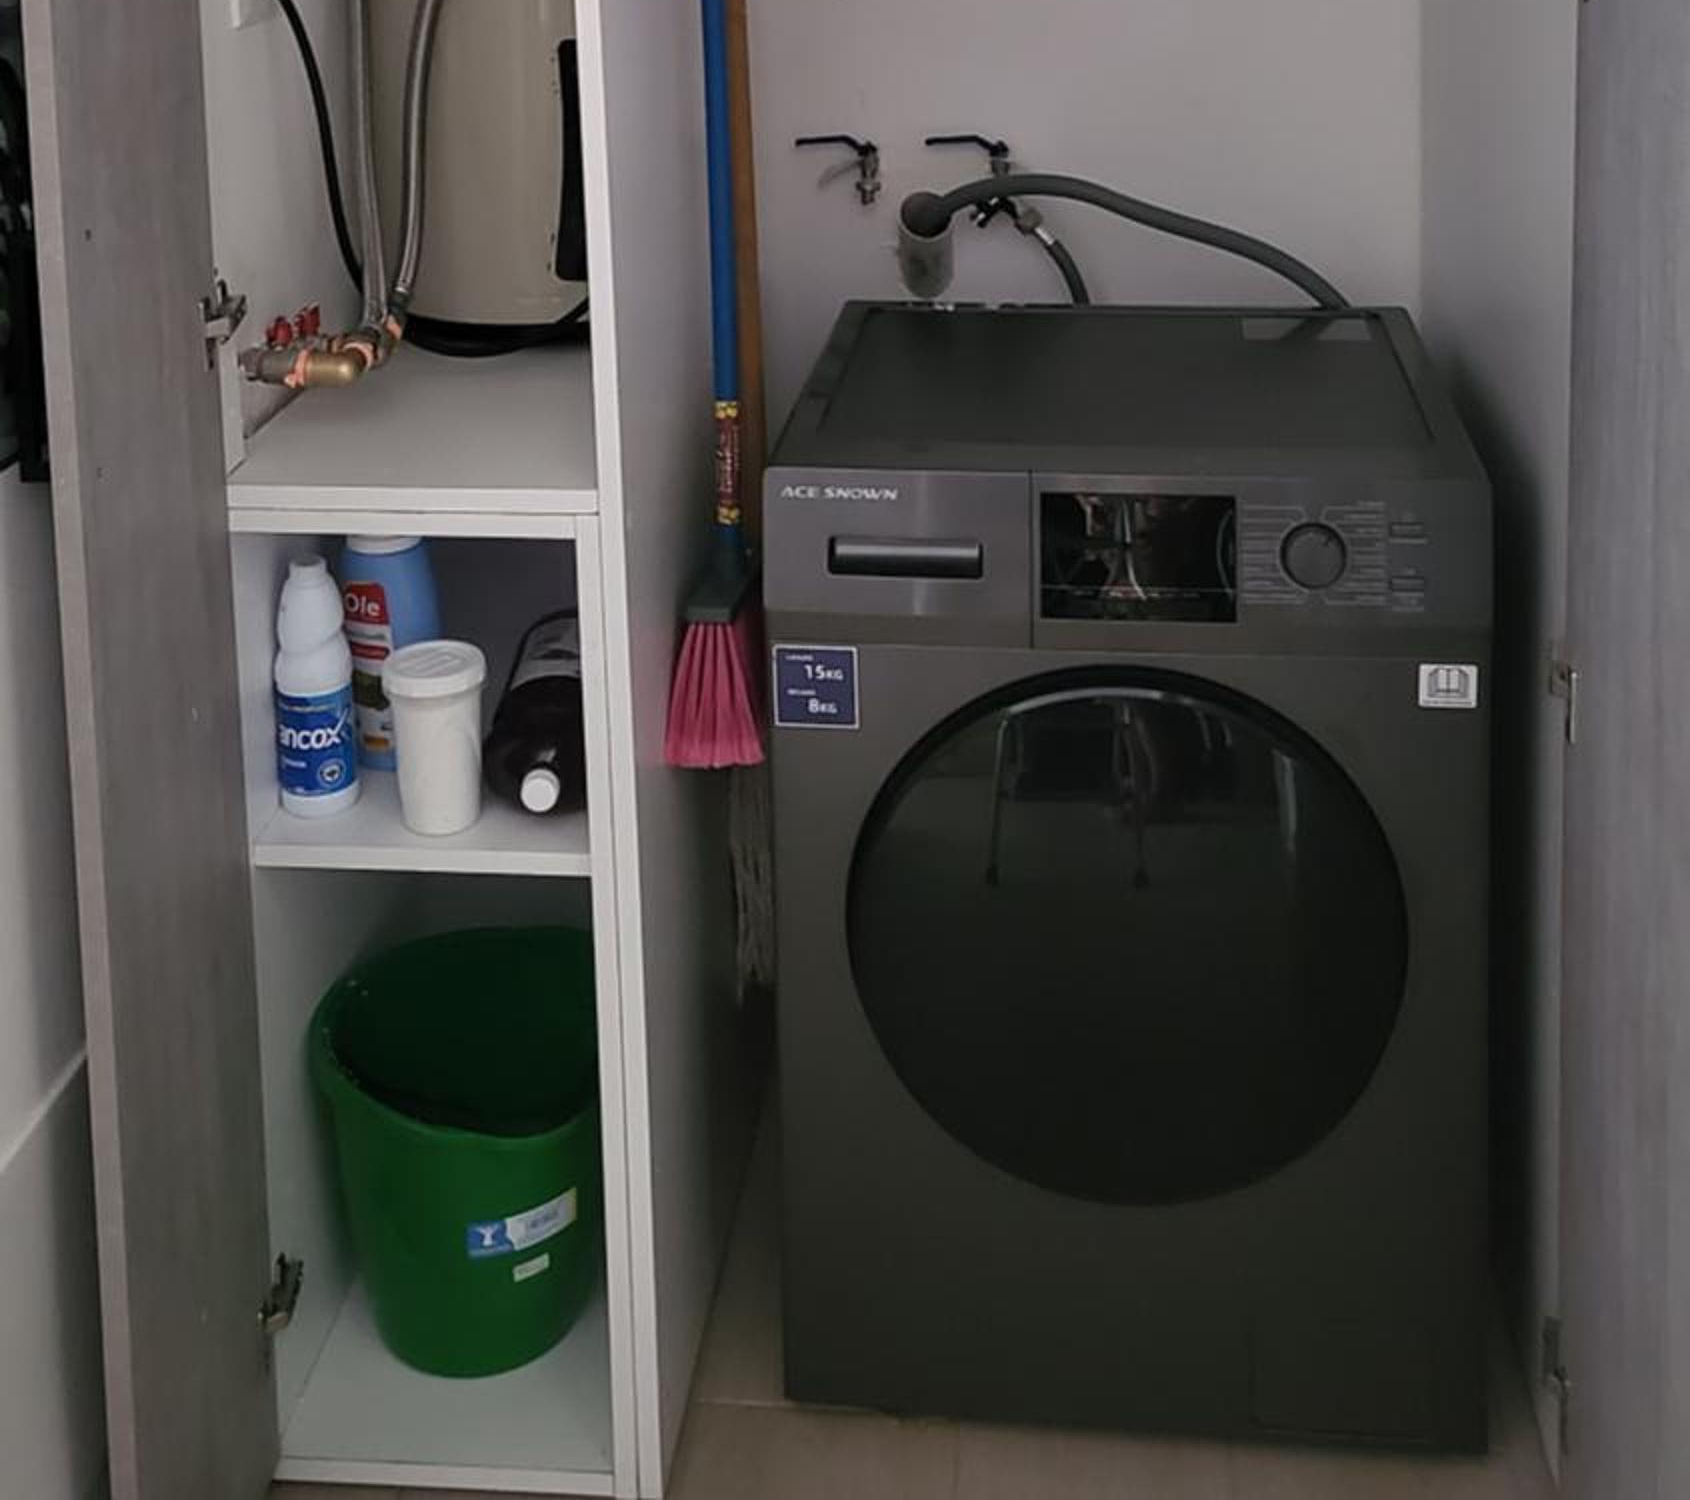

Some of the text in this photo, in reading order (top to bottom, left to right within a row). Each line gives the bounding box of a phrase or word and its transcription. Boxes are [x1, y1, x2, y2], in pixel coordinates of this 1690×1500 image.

[781, 485, 898, 501] ACE SNOWN
[345, 593, 381, 617] Ole
